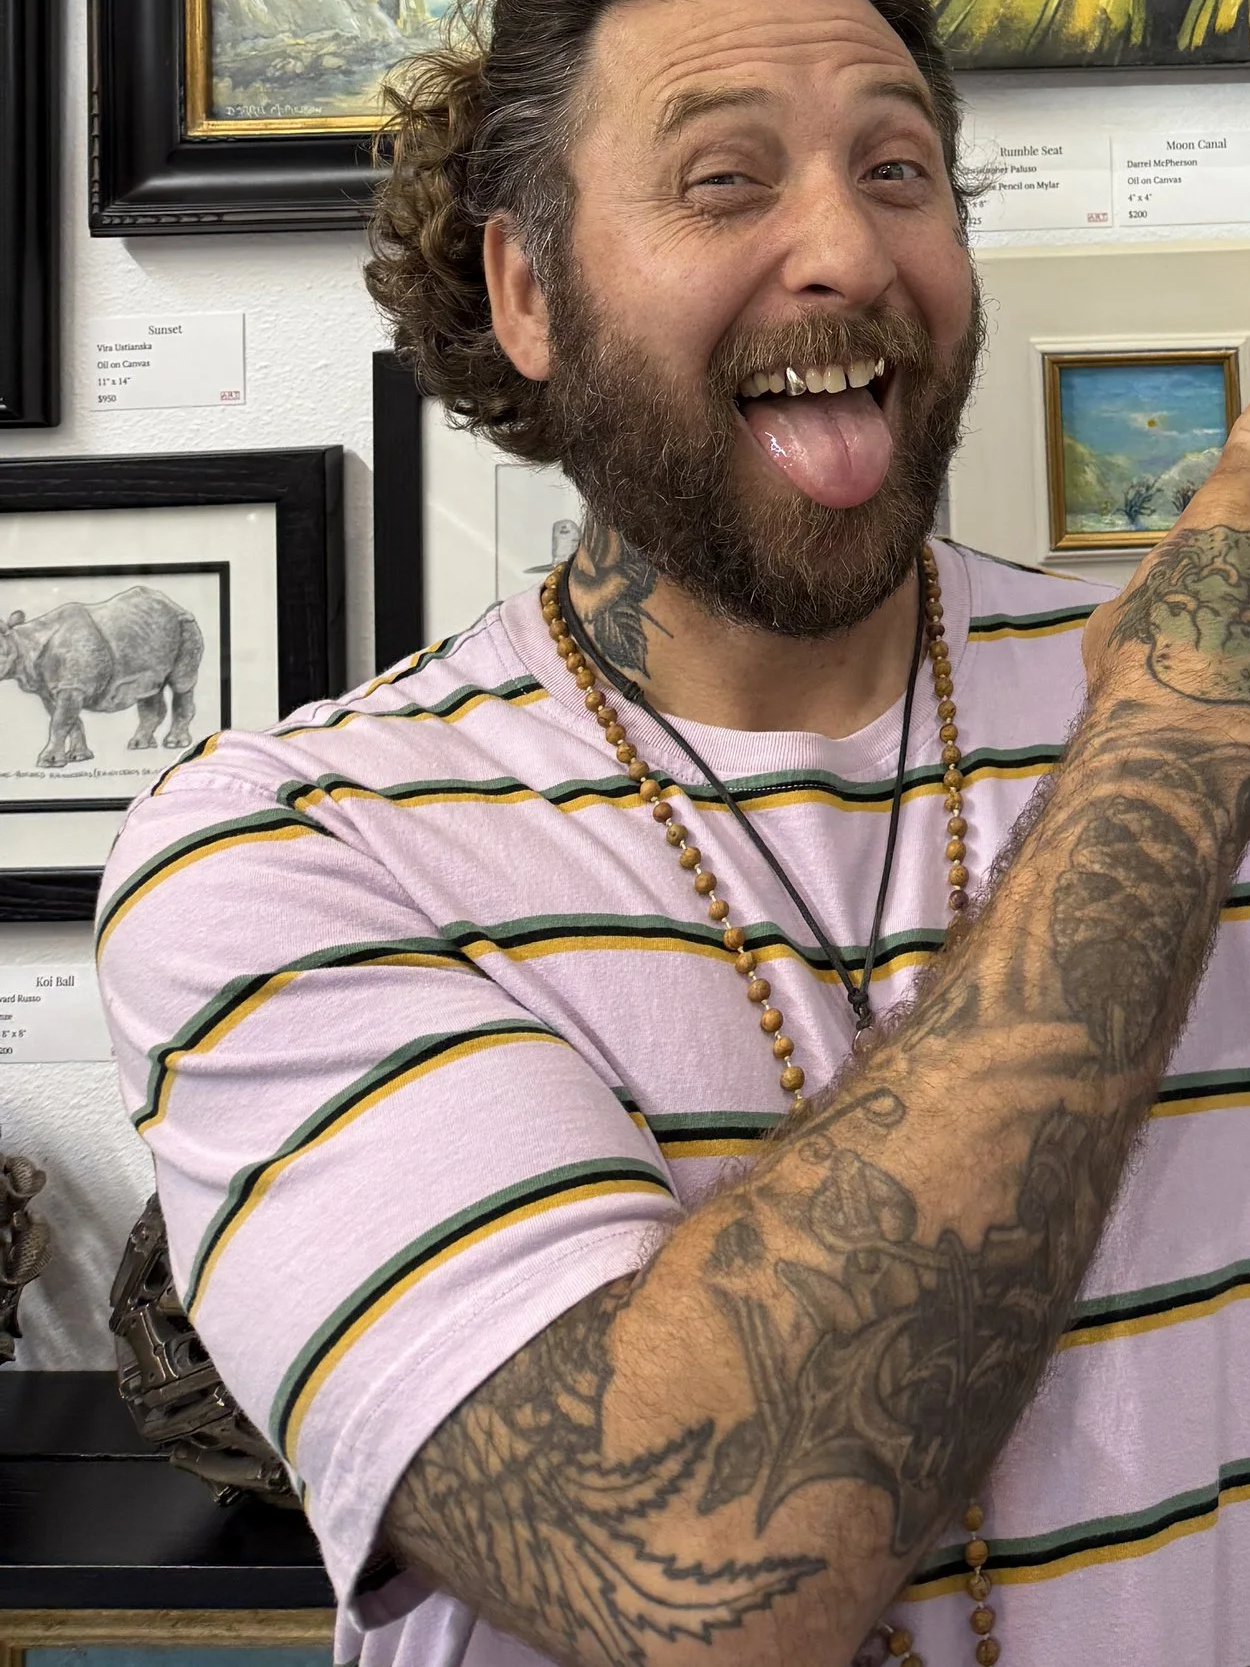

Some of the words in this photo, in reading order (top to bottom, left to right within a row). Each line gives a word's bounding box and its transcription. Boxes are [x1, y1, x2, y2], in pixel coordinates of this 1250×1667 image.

[1166, 140, 1195, 150] Moon
[1197, 138, 1227, 150] Canal
[1000, 146, 1039, 157] Rumble
[1041, 146, 1063, 155] Seat
[1127, 160, 1151, 168] Darrel
[1153, 159, 1198, 168] McPherson
[1010, 165, 1037, 173] Paluso
[1127, 177, 1140, 185] Oil
[1153, 176, 1182, 184] Canvas
[1000, 182, 1023, 191] Pencil
[1036, 181, 1060, 190] Mylar
[1087, 213, 1108, 223] ART
[1128, 210, 1148, 219] $200
[148, 324, 183, 336] Sunset
[97, 343, 113, 353] Vira
[114, 342, 153, 352] Ustianska
[97, 361, 109, 369] Oil
[110, 361, 121, 369] on
[122, 360, 150, 368] Canvas
[118, 377, 131, 386] 14"
[98, 394, 117, 403] $950
[220, 391, 240, 401] ART
[36, 976, 53, 987] Koi
[55, 975, 75, 987] Ball
[17, 994, 41, 1003] Russo
[11, 1030, 17, 1038] x
